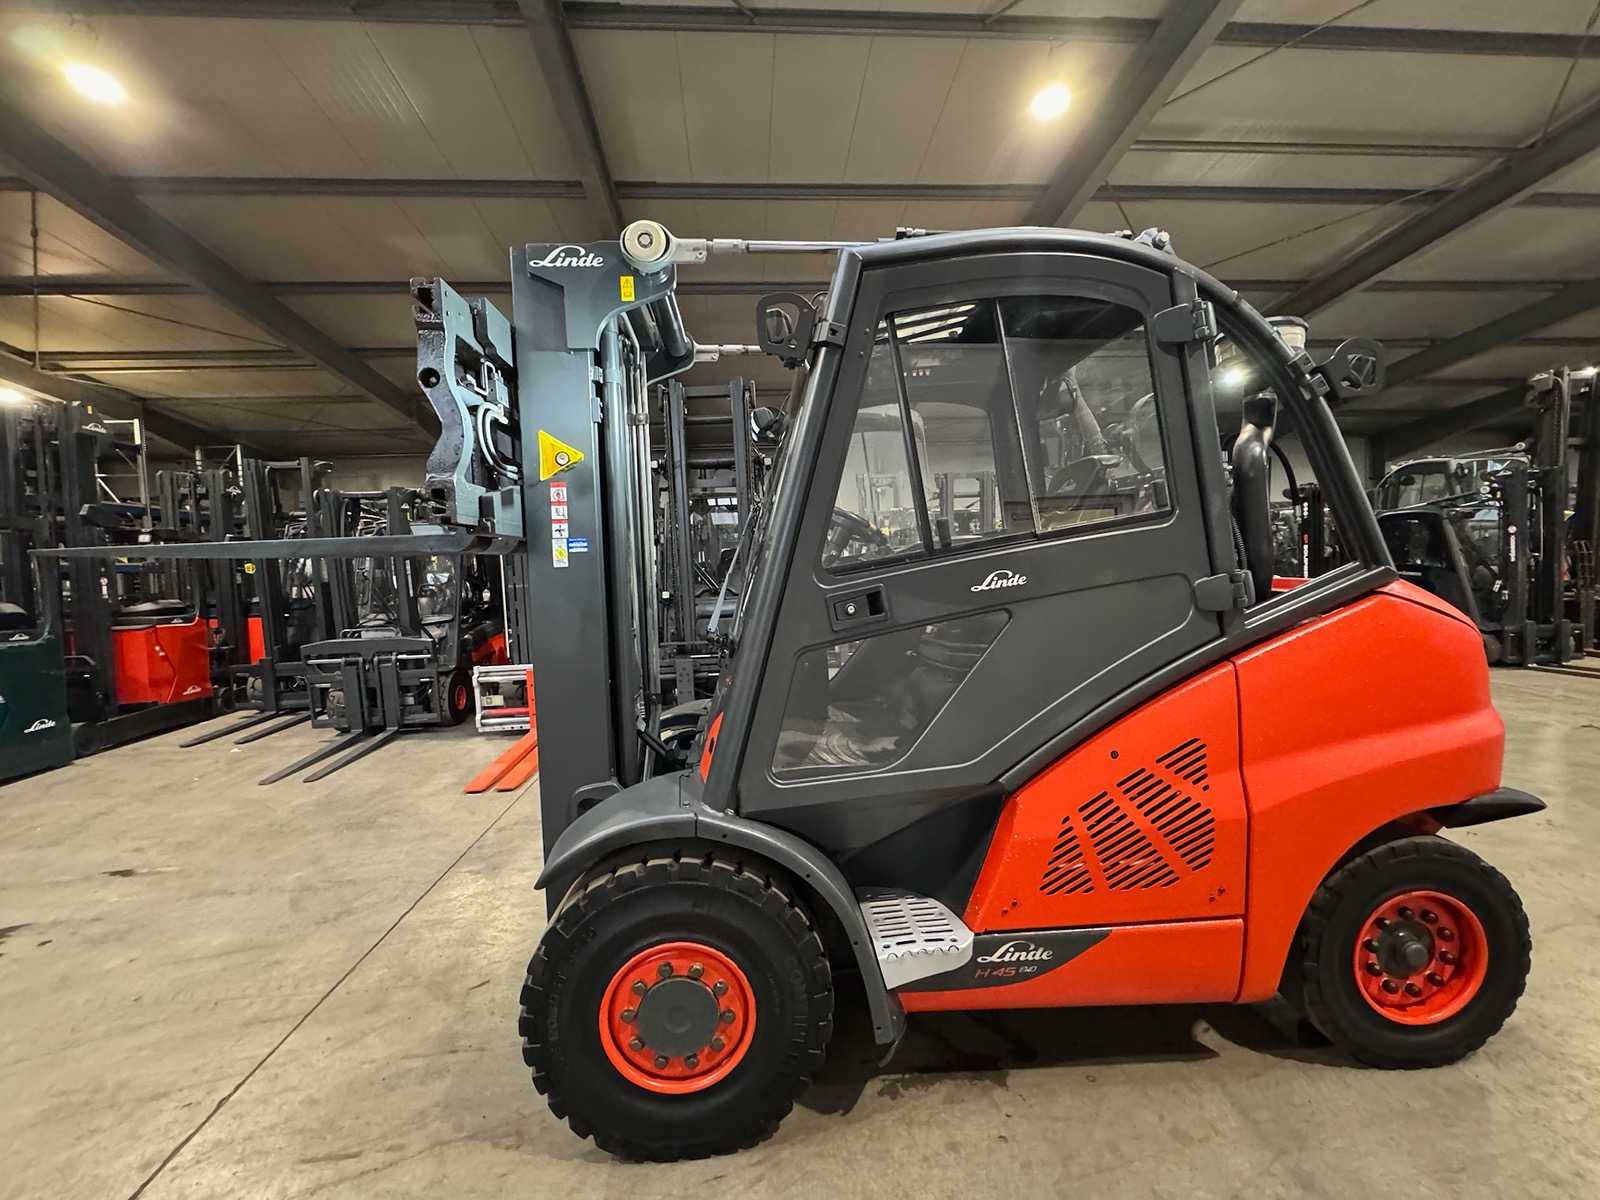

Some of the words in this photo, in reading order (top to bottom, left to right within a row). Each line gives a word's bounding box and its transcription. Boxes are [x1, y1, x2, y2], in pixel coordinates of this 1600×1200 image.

[529, 245, 604, 267] Linde
[970, 570, 1027, 592] Linde
[24, 718, 56, 733] Linde
[977, 940, 1053, 963] Linde
